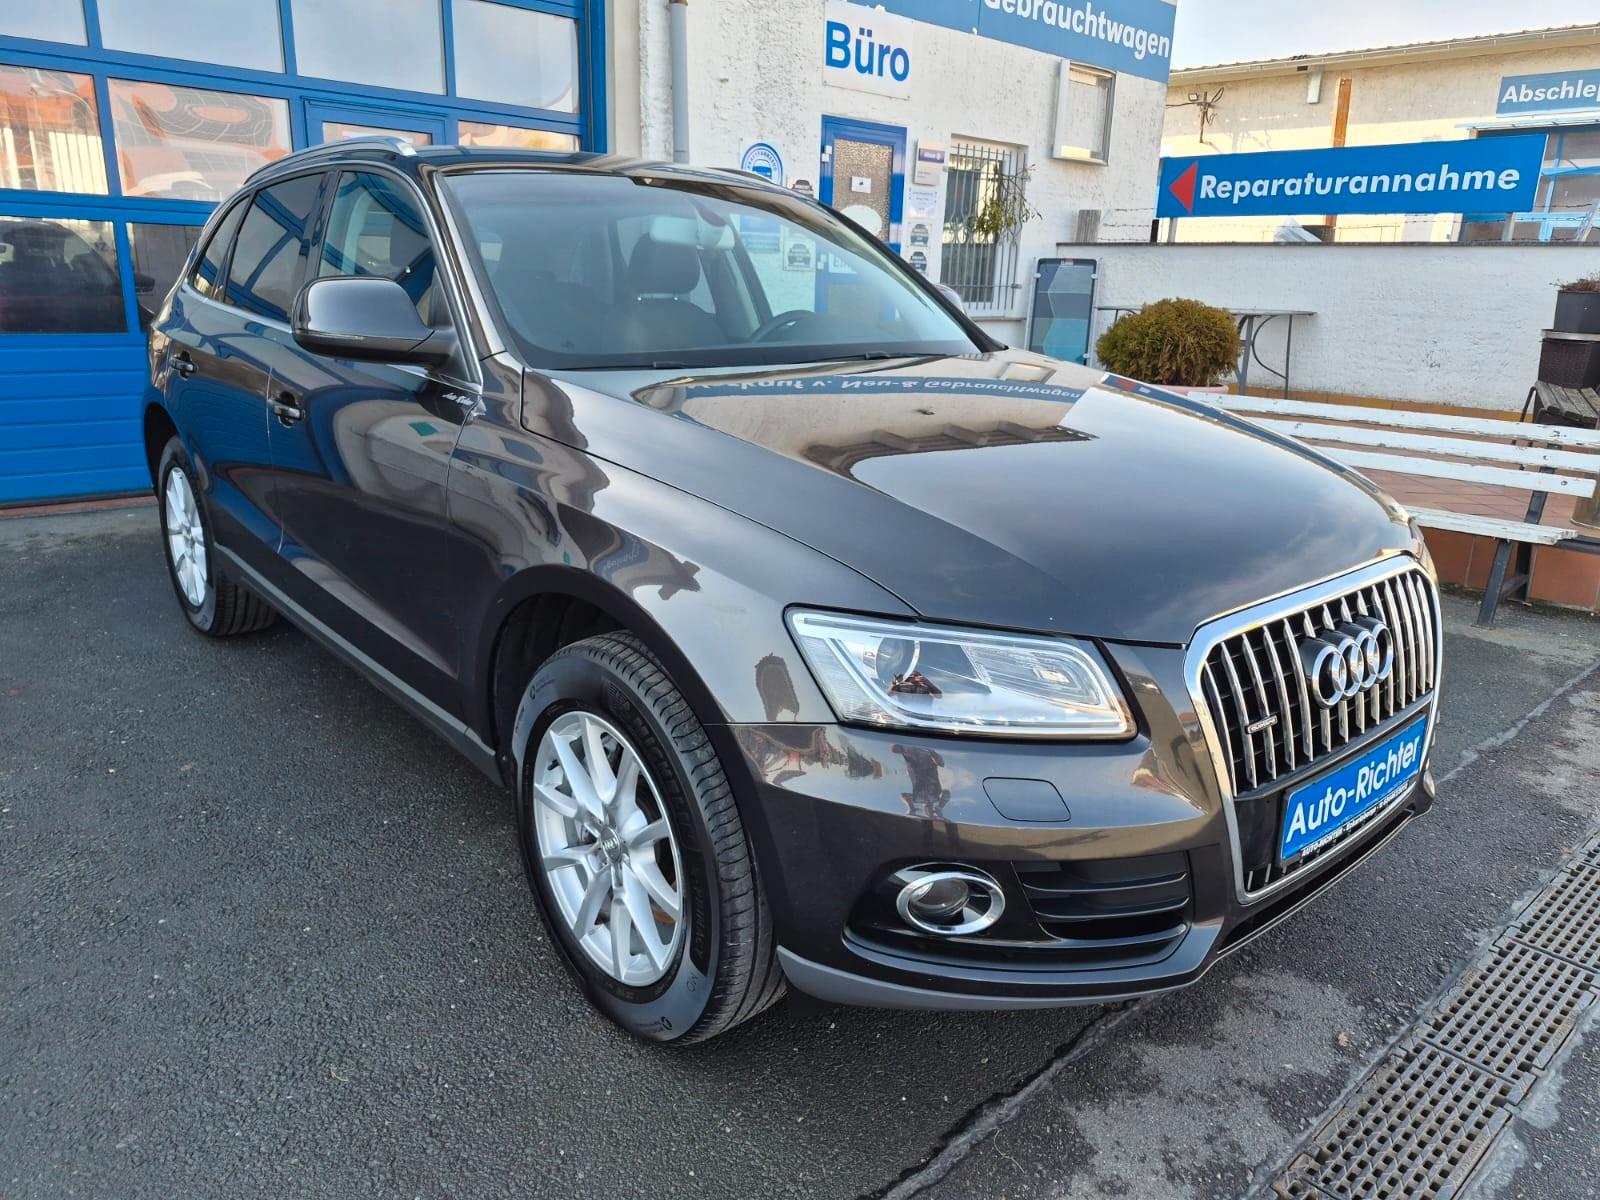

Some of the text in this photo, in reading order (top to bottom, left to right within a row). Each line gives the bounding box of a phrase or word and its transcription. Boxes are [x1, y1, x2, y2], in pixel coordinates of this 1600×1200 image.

[826, 22, 910, 82] Büro
[1501, 80, 1600, 103] Abschle
[1200, 163, 1520, 204] Reparaturannahme
[1286, 736, 1420, 843] Auto-Richter
